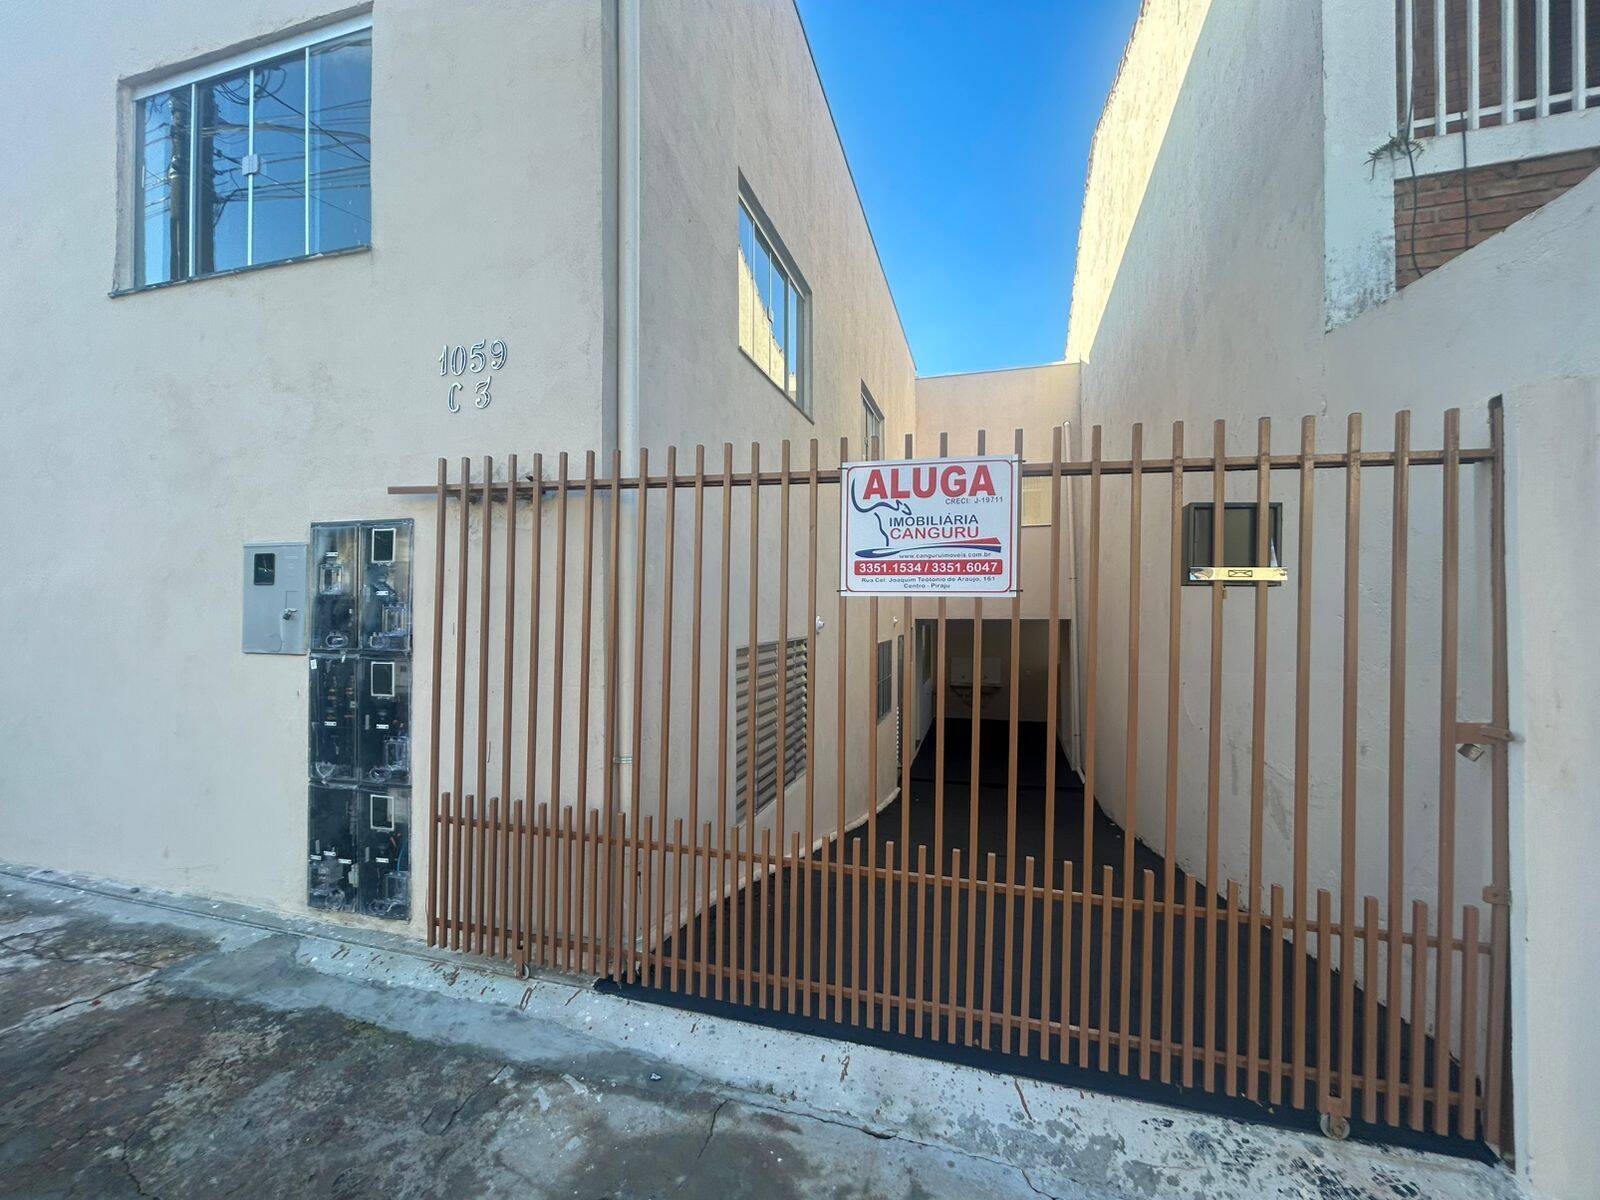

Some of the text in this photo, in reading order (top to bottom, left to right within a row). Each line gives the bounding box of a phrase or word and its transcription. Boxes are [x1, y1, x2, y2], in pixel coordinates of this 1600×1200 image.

[439, 339, 507, 376] 1059
[448, 376, 491, 413] C 3
[862, 465, 996, 499] ALUGA
[889, 513, 979, 526] IMOBILIÁRIA
[890, 526, 979, 540] CANGURU
[859, 563, 922, 573] 3351.1534
[931, 562, 998, 573] 3351.6047
